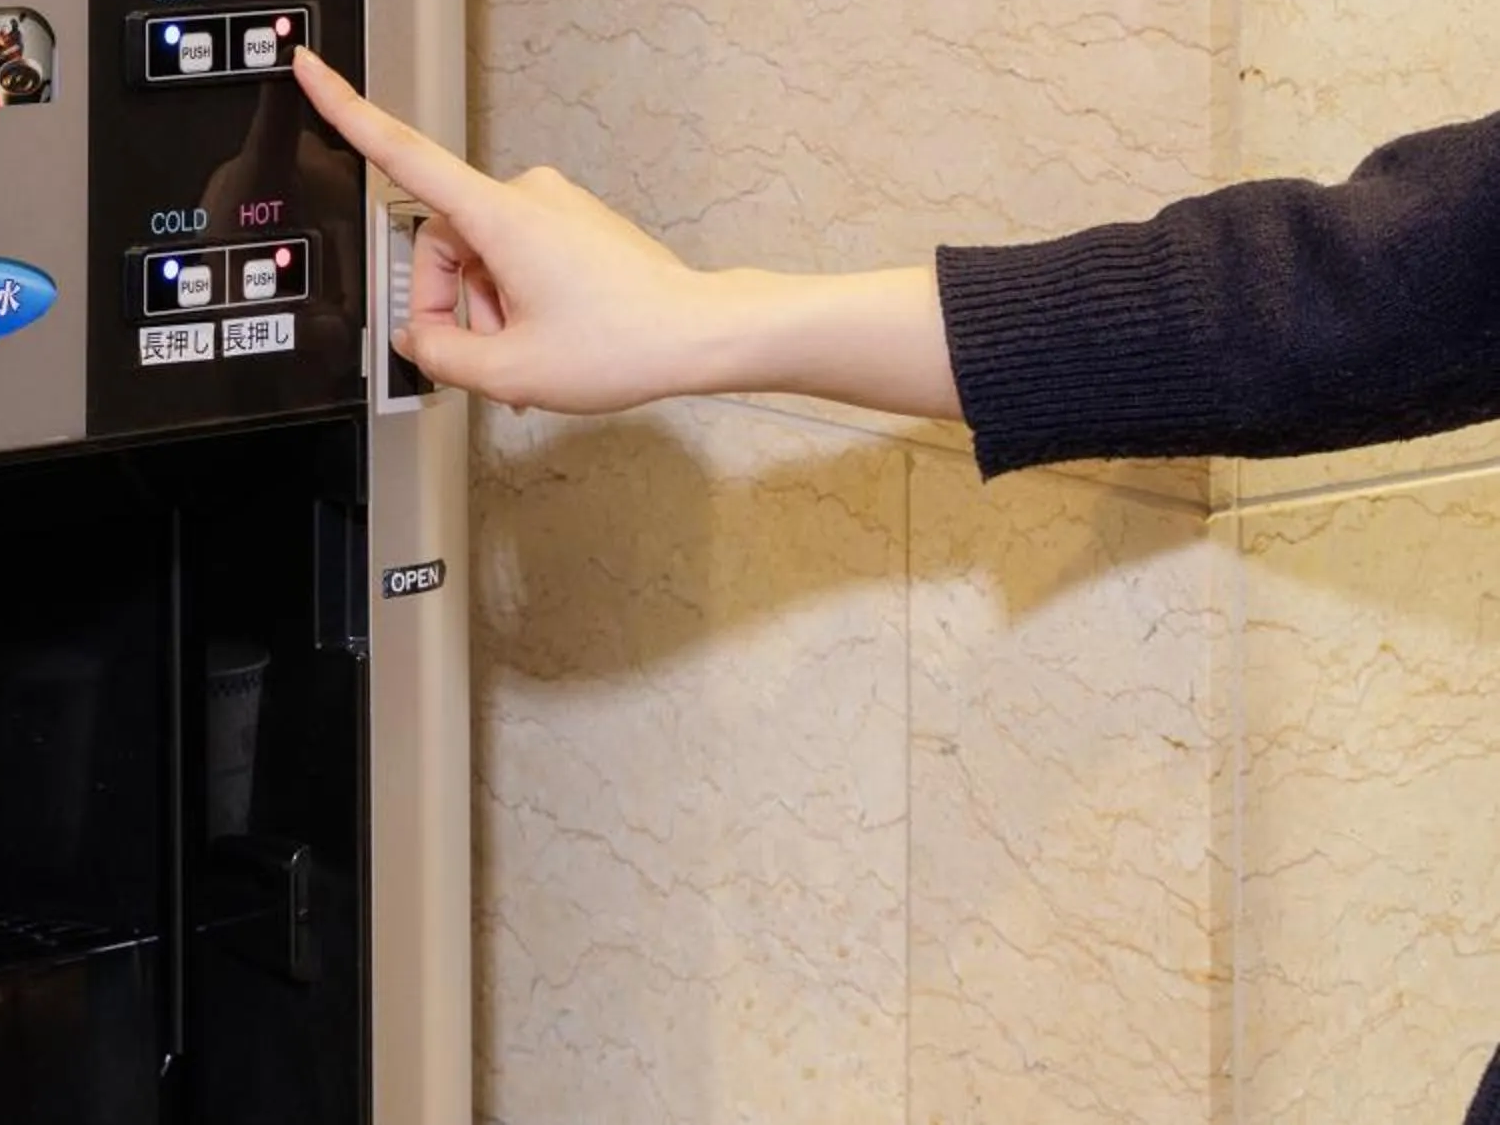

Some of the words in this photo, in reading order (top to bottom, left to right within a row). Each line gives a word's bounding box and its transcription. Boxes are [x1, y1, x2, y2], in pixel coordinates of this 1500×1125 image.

[182, 44, 211, 60] PUSH
[247, 40, 275, 56] PUSH
[151, 208, 207, 235] COLD
[240, 201, 284, 226] HOT
[181, 278, 209, 294] PUSH
[246, 272, 275, 288] PUSH
[143, 330, 210, 362] 長押し
[224, 320, 291, 352] 長押し
[391, 563, 439, 592] OPEN
